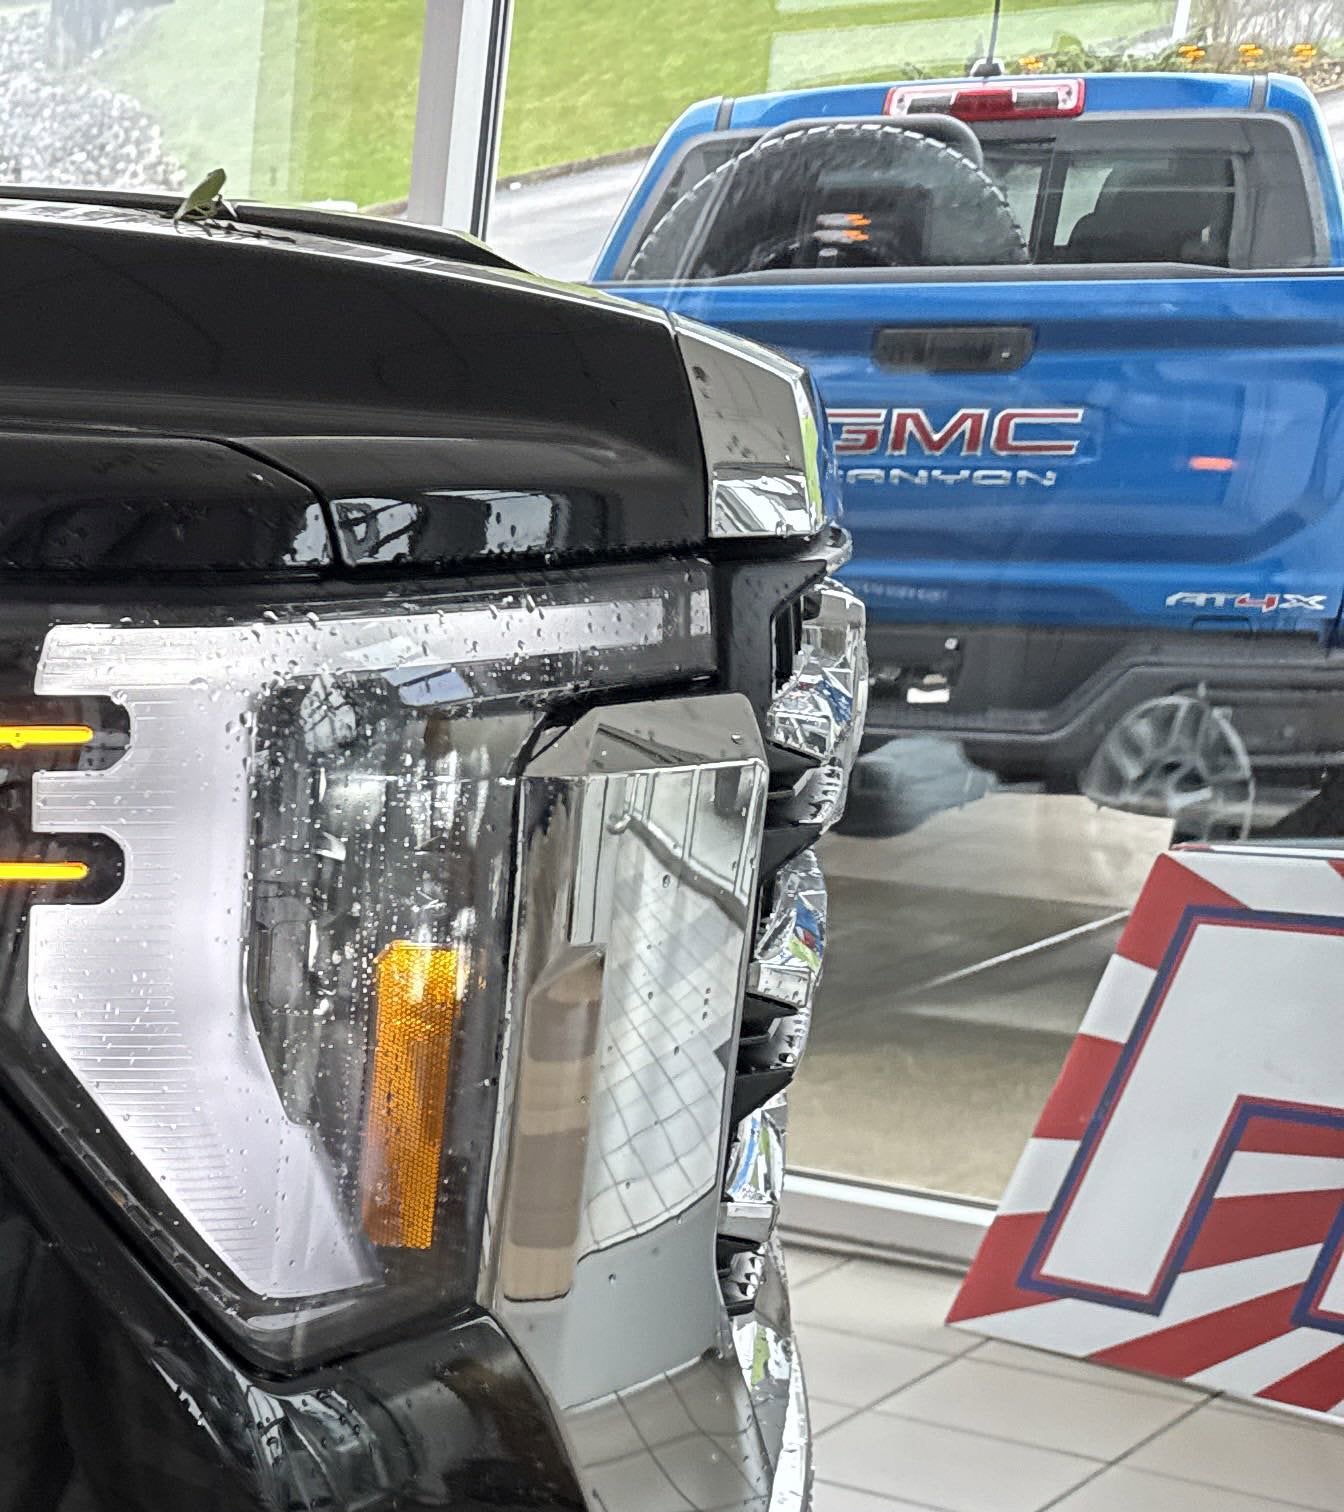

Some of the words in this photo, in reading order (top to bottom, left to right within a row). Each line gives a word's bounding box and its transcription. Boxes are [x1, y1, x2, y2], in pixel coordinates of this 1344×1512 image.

[826, 408, 1084, 457] GMC
[838, 468, 1057, 487] ANYON
[1166, 592, 1327, 613] AT4X
